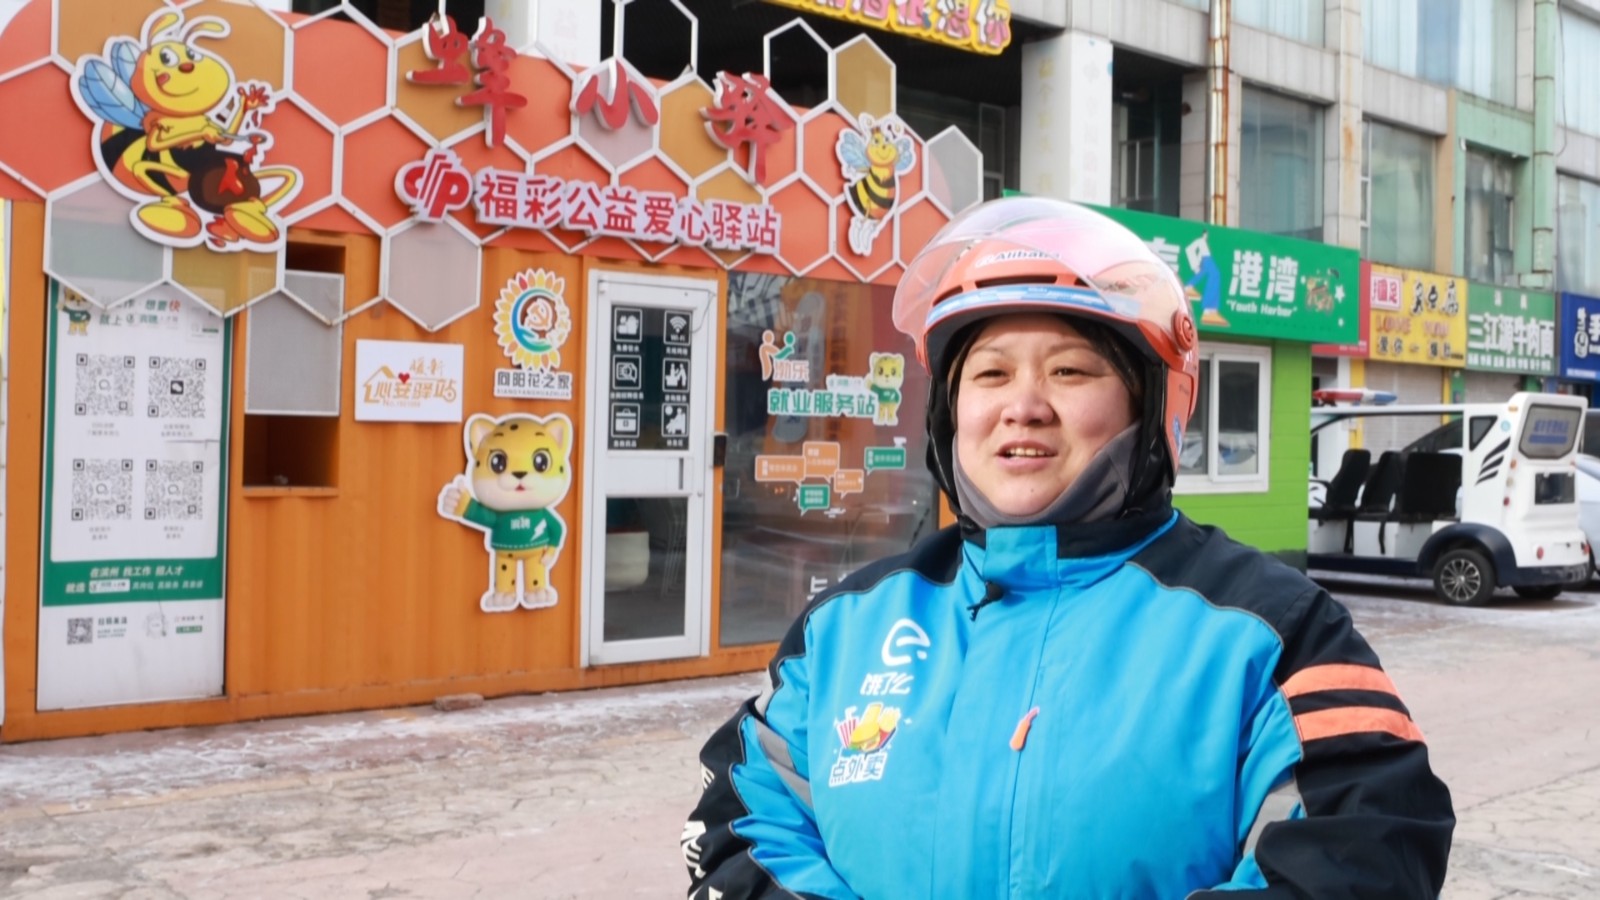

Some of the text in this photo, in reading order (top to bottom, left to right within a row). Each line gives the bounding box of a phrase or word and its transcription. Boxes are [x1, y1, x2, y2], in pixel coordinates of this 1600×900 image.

[479, 173, 777, 248] 福彩公益爱心驿站
[1228, 249, 1299, 303] 港湾
[497, 371, 570, 389] 向阳花之家
[769, 391, 876, 415] 就业服务站
[860, 672, 914, 696] 饿了么
[831, 752, 887, 785] 点外卖
